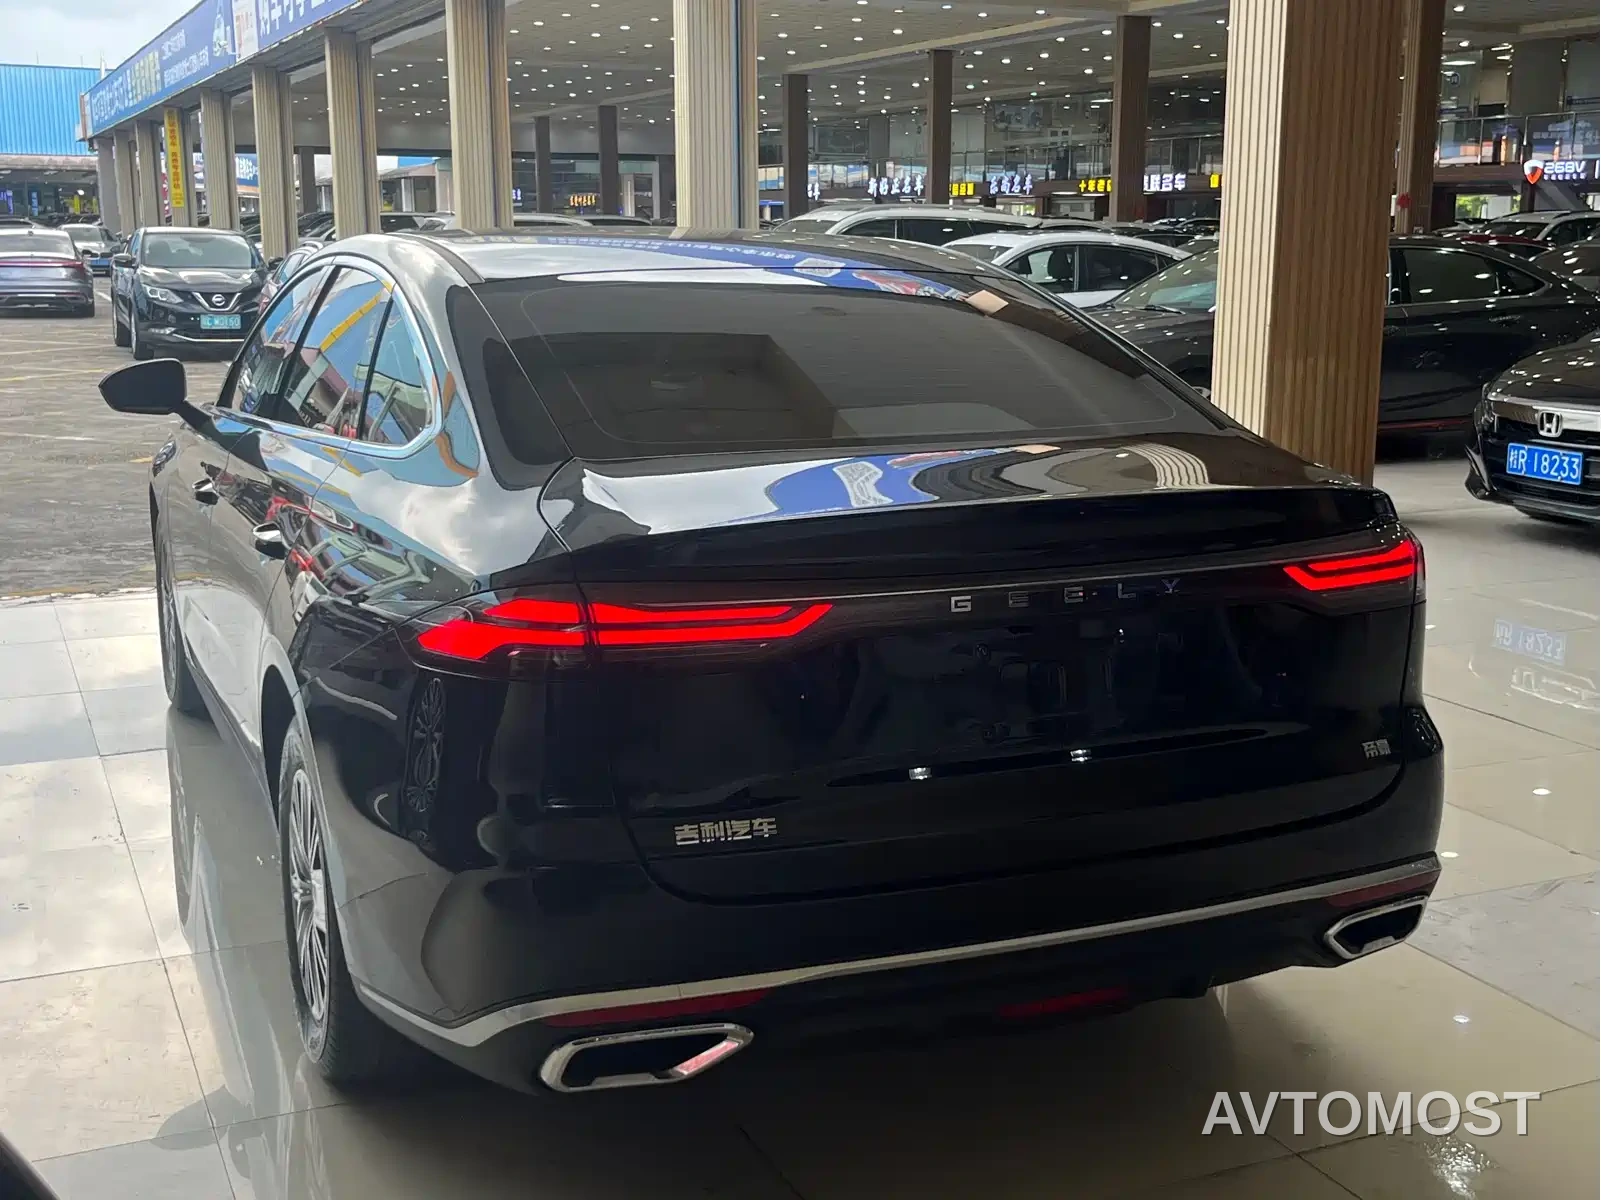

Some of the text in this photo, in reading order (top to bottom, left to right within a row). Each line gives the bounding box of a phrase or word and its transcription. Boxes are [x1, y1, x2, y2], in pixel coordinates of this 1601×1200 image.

[950, 578, 1180, 613] GEELY
[674, 817, 777, 846] 吉利汽车
